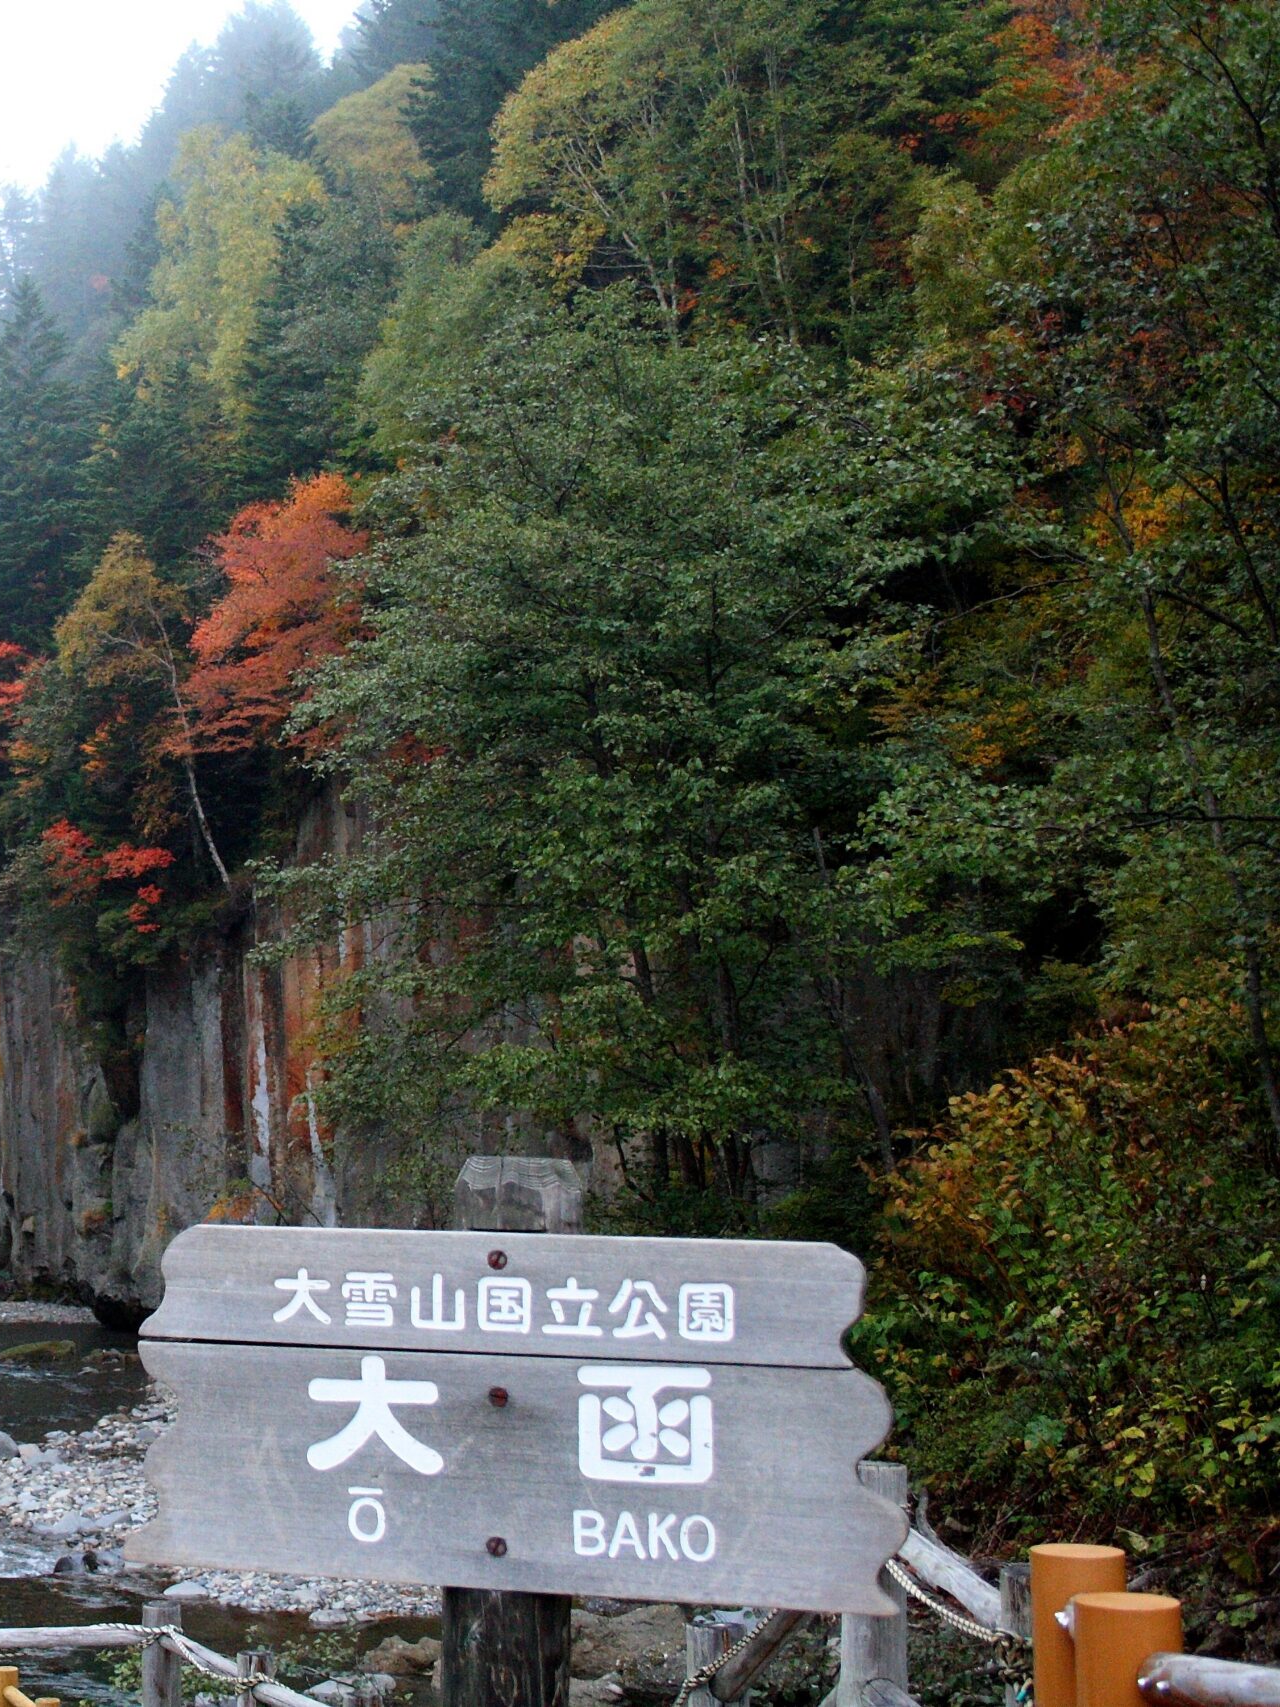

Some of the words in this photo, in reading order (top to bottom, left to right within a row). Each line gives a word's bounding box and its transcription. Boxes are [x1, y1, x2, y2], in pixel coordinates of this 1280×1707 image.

[274, 1268, 734, 1342] 大雪山国立公園
[573, 1510, 716, 1562] BAKO
